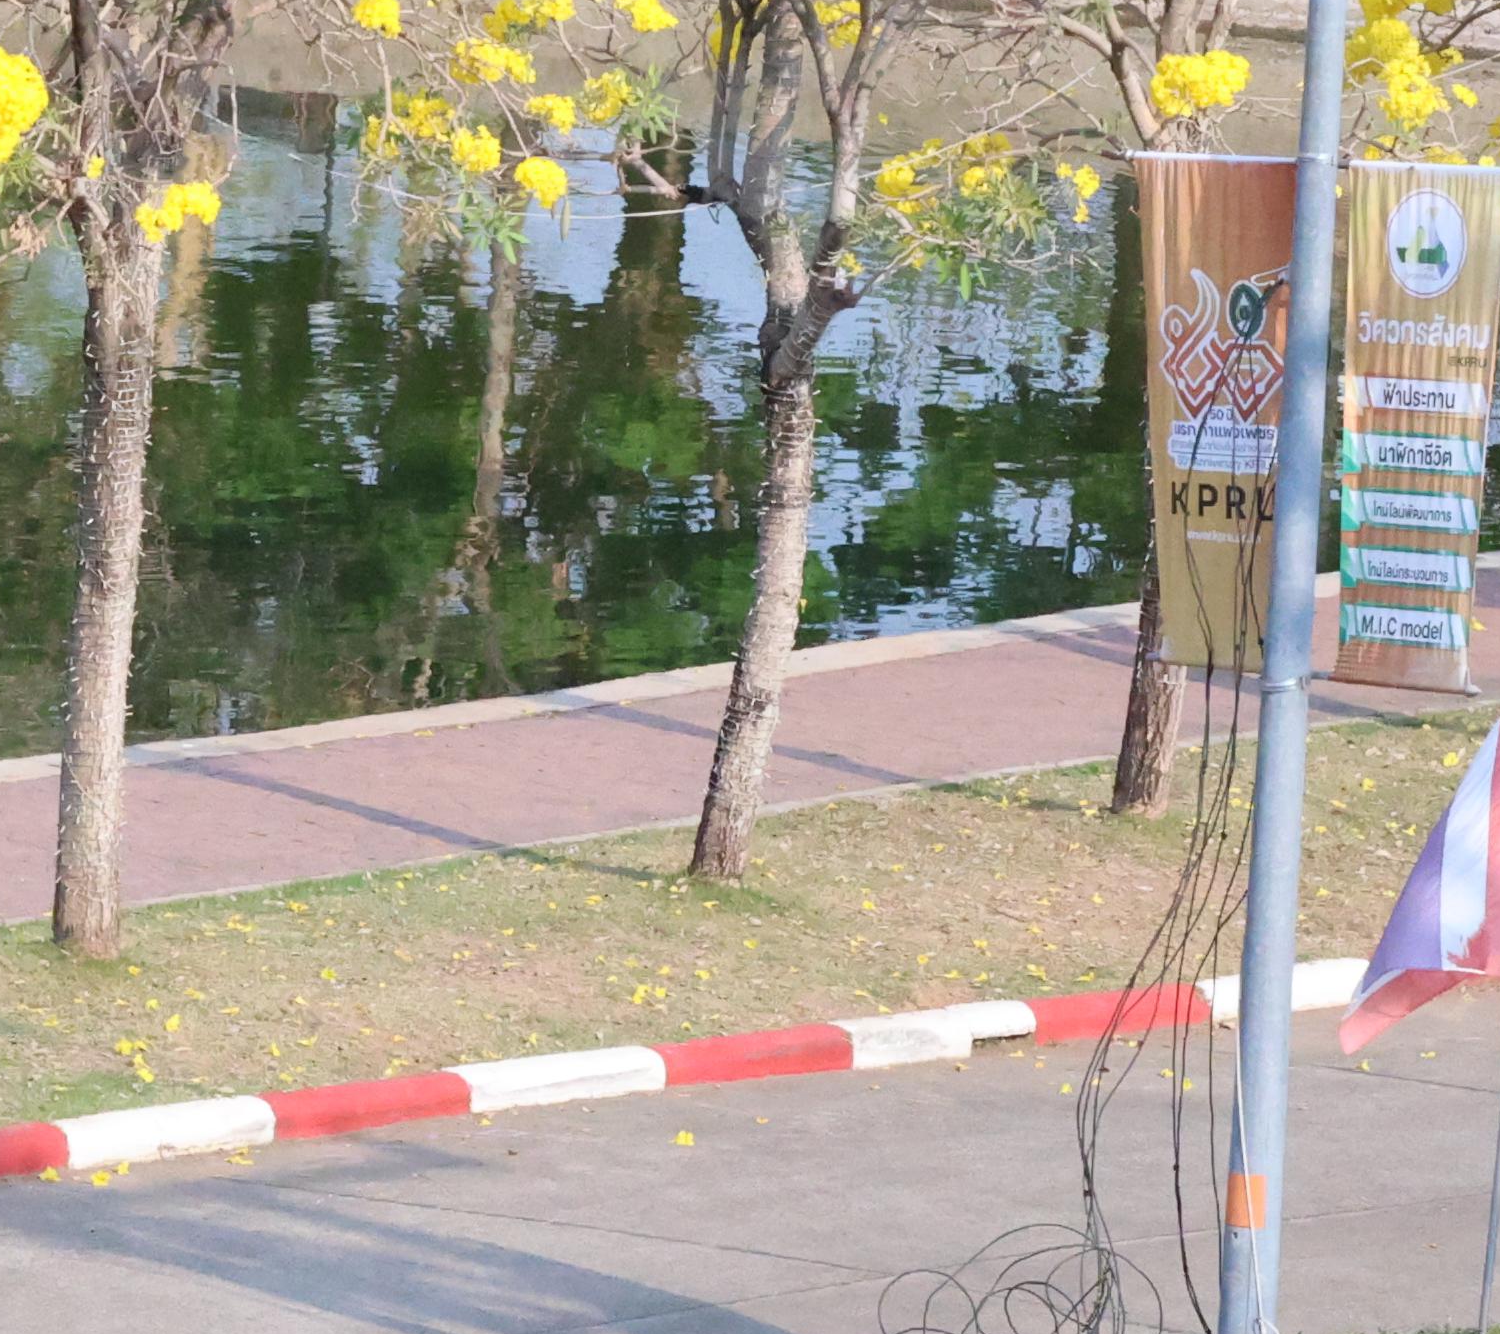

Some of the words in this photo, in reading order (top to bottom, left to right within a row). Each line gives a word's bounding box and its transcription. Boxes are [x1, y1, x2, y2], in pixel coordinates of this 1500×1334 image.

[1358, 311, 1490, 351] วิศวกรสังคม
[1383, 381, 1456, 409] ฟ้าประทาน
[1378, 442, 1453, 467] นาฬิกาชีวิต
[1361, 615, 1398, 636] M.I.C
[1401, 621, 1444, 640] model
